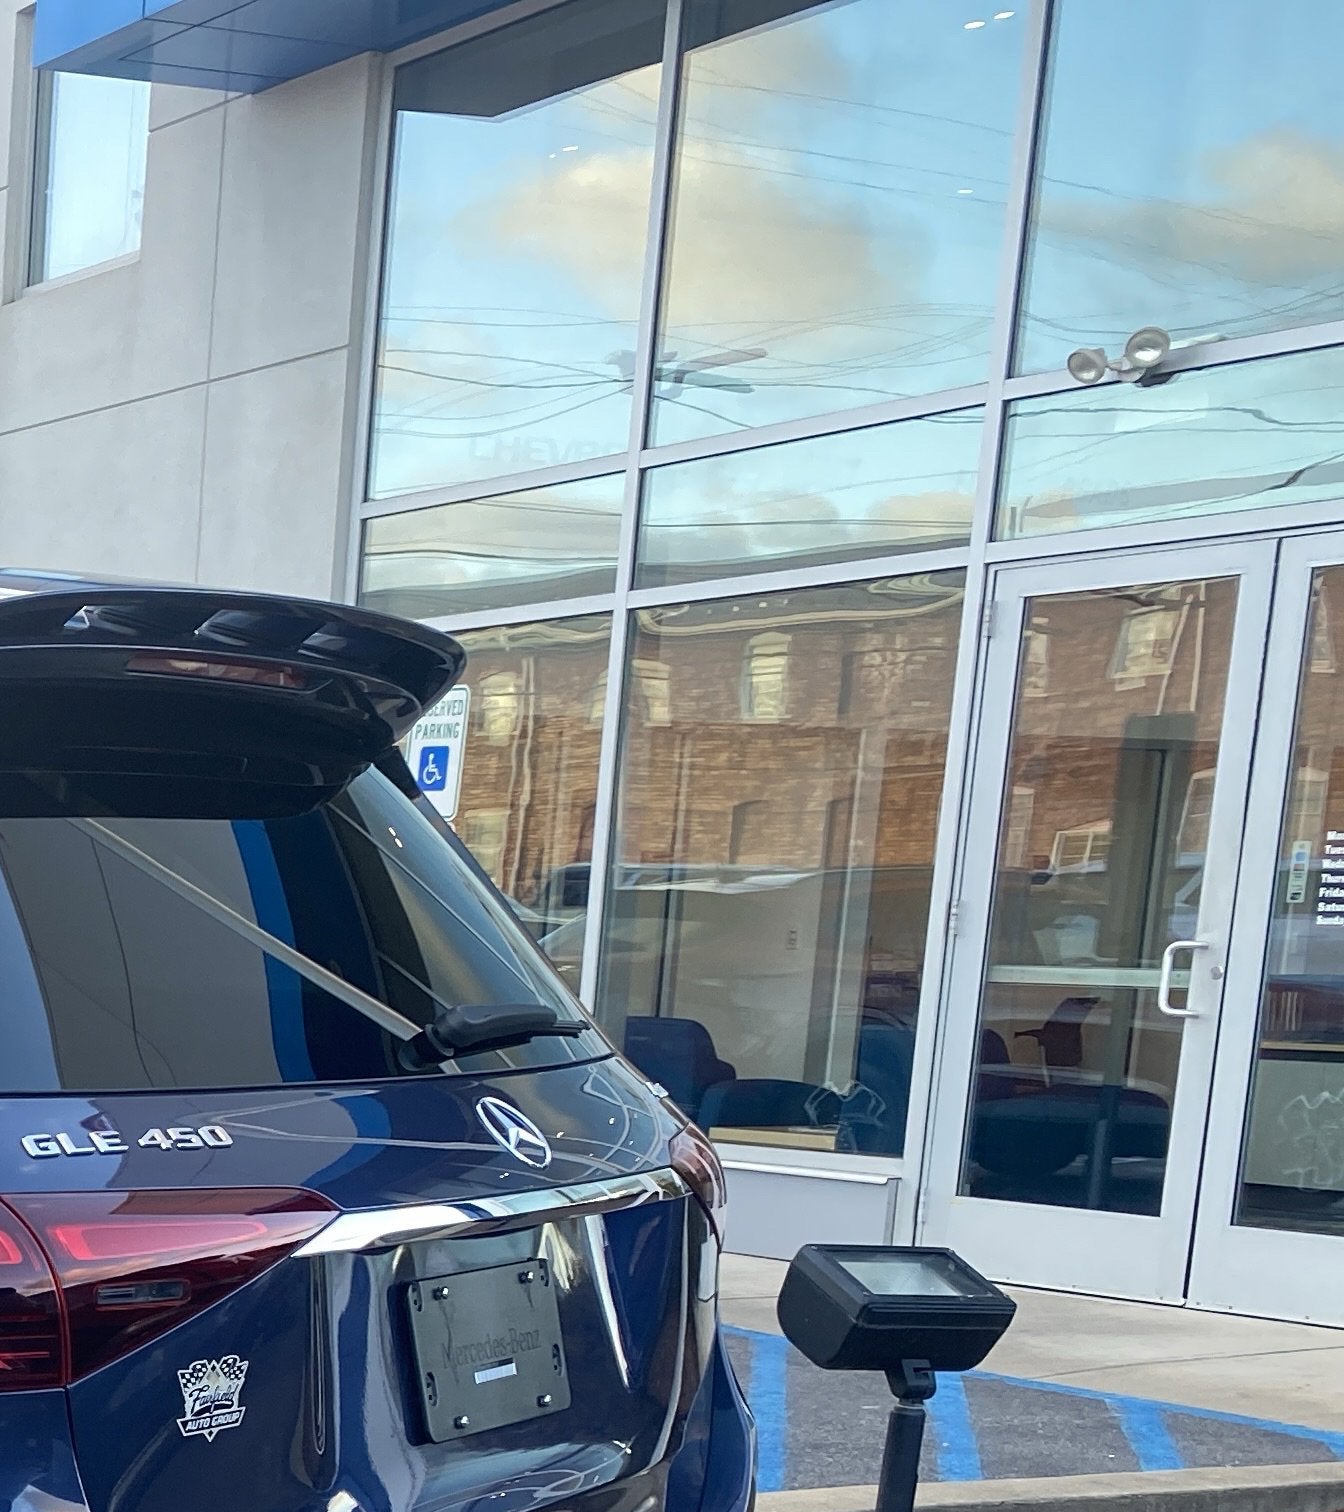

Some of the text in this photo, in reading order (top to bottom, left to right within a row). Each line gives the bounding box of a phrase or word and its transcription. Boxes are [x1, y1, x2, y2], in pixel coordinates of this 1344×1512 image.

[414, 722, 460, 740] PARKING
[21, 1125, 234, 1159] GLE 450
[441, 1327, 542, 1369] Mercedes-Benz
[185, 1411, 240, 1431] AUTO GROUP
